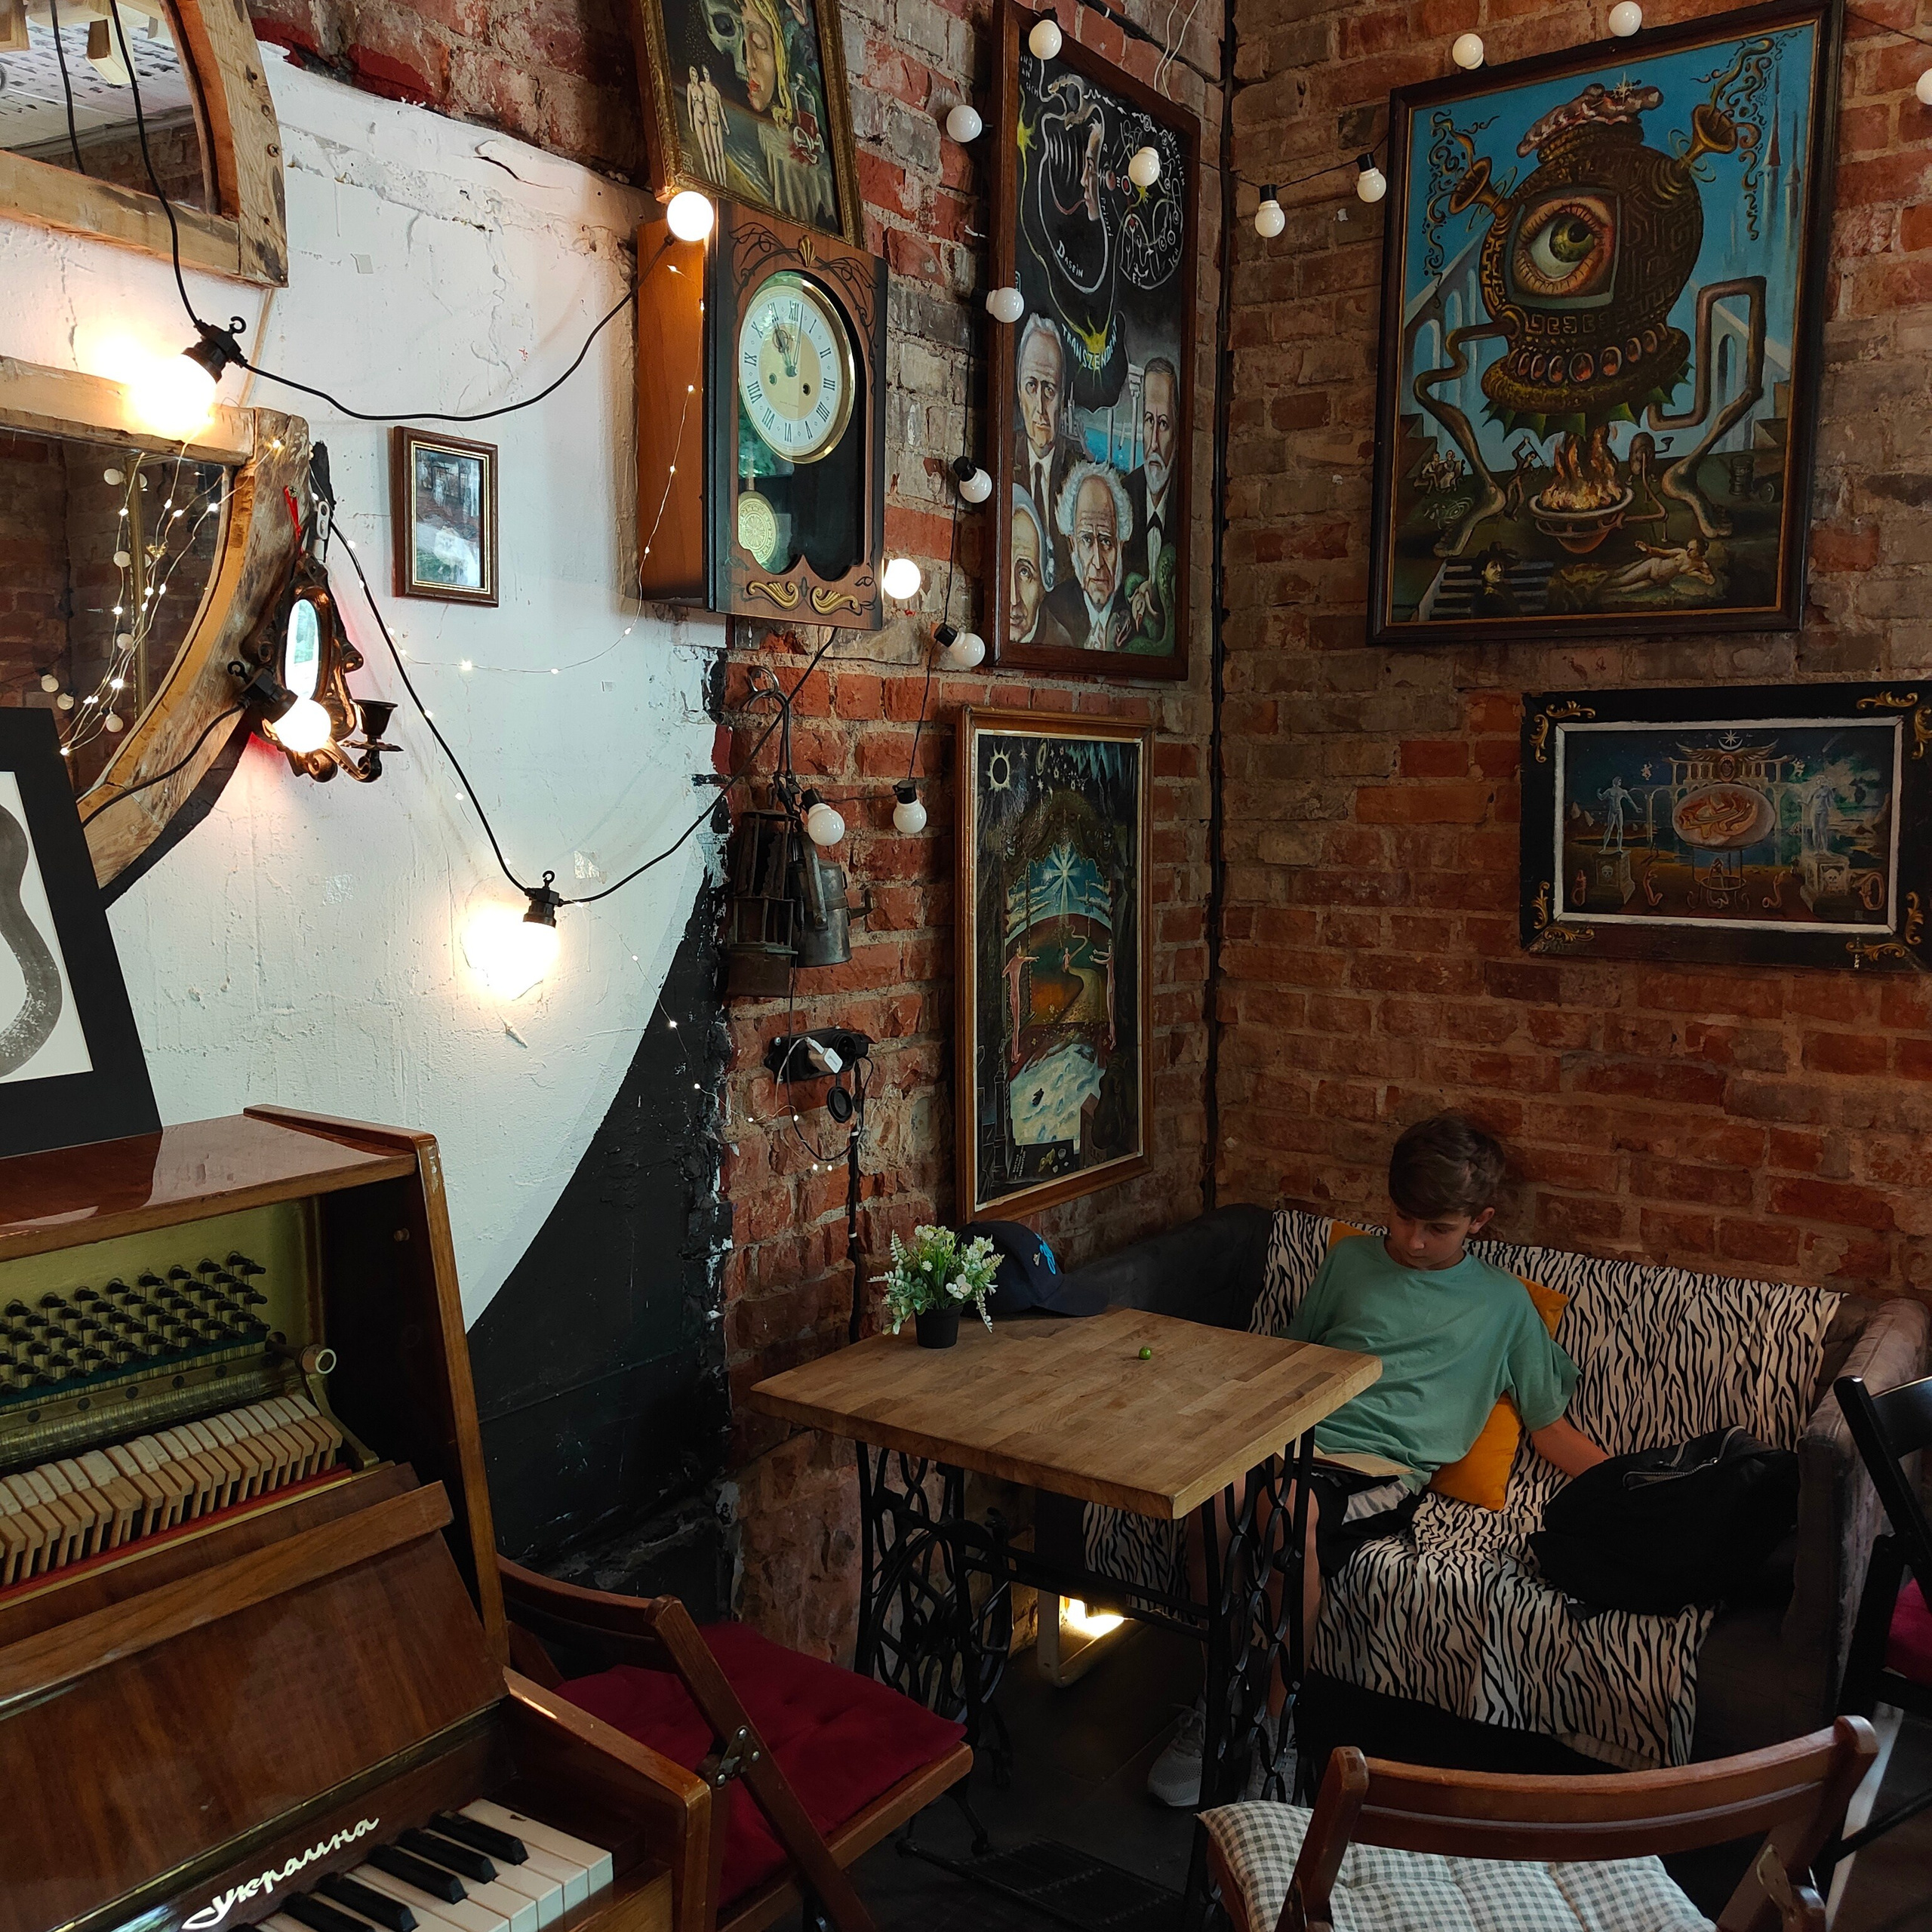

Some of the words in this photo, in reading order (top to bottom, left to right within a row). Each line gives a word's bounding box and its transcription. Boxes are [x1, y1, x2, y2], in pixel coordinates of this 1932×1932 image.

[744, 352, 758, 367] IX
[820, 347, 832, 359] II
[747, 380, 763, 404] VIII
[823, 377, 835, 392] III
[761, 408, 776, 431] VII
[784, 422, 792, 443] VI
[804, 420, 814, 440] V
[181, 1817, 380, 1930] Украина
